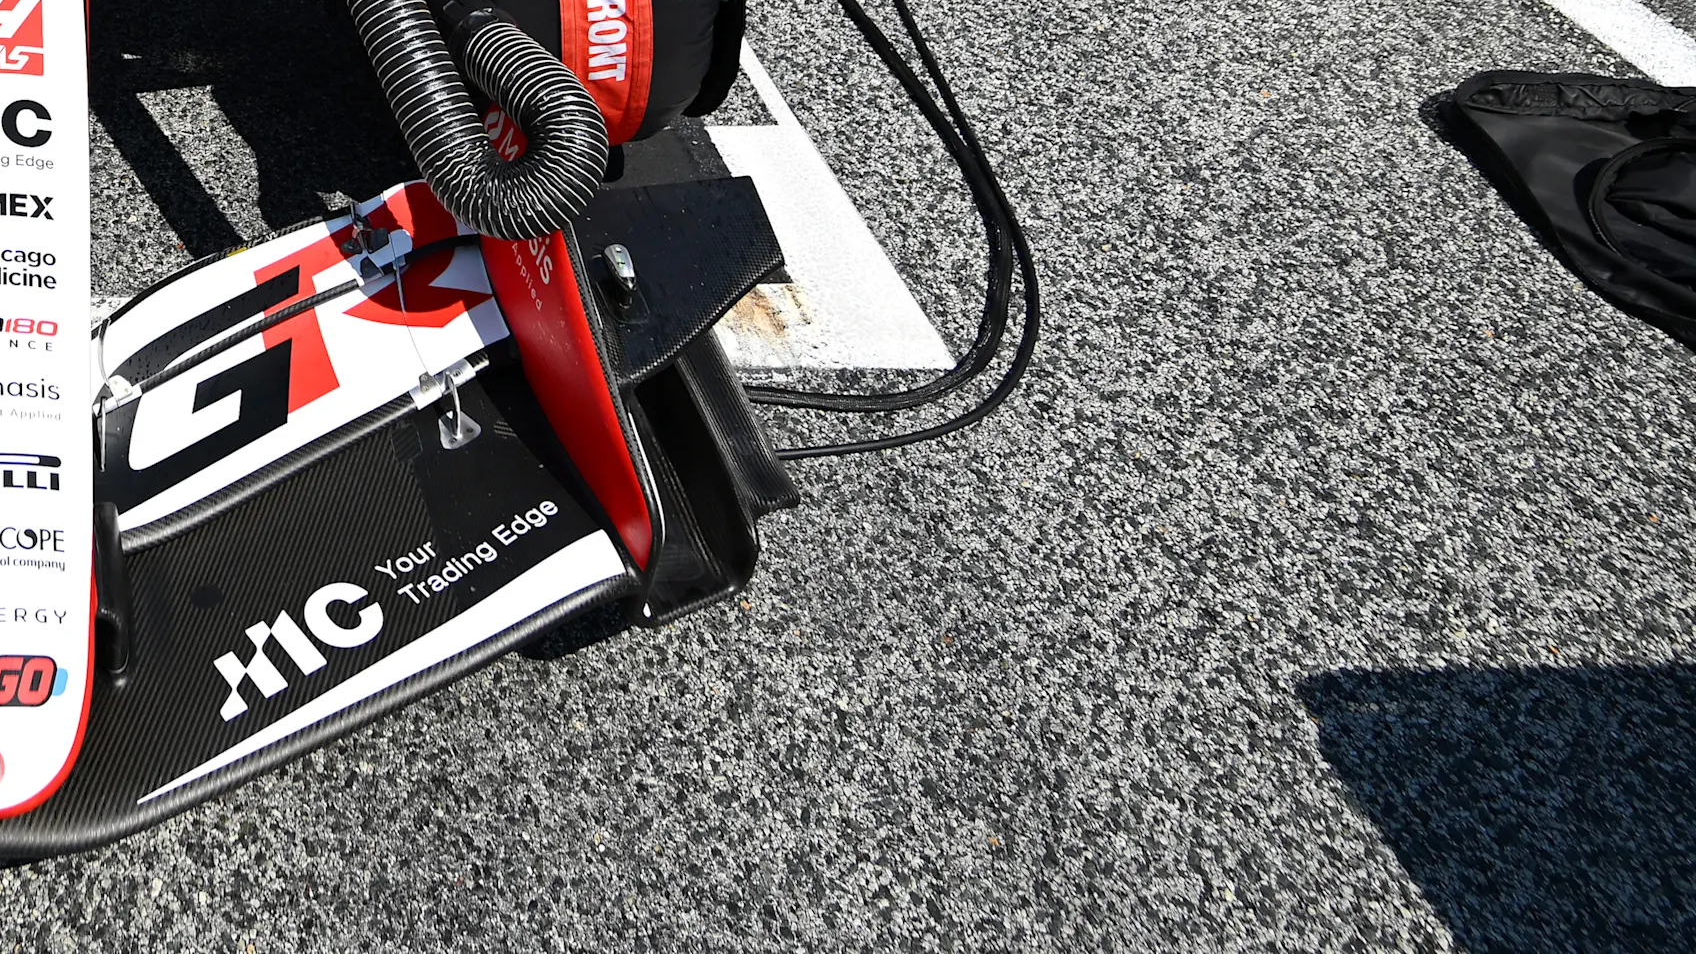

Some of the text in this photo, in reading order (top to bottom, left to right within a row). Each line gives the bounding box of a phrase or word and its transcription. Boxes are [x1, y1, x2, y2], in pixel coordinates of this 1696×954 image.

[15, 155, 54, 170] Edge
[510, 240, 543, 311] Applied
[10, 408, 61, 421] Applied
[12, 557, 66, 573] company
[375, 540, 437, 581] Your
[397, 499, 559, 606] Trading Edge
